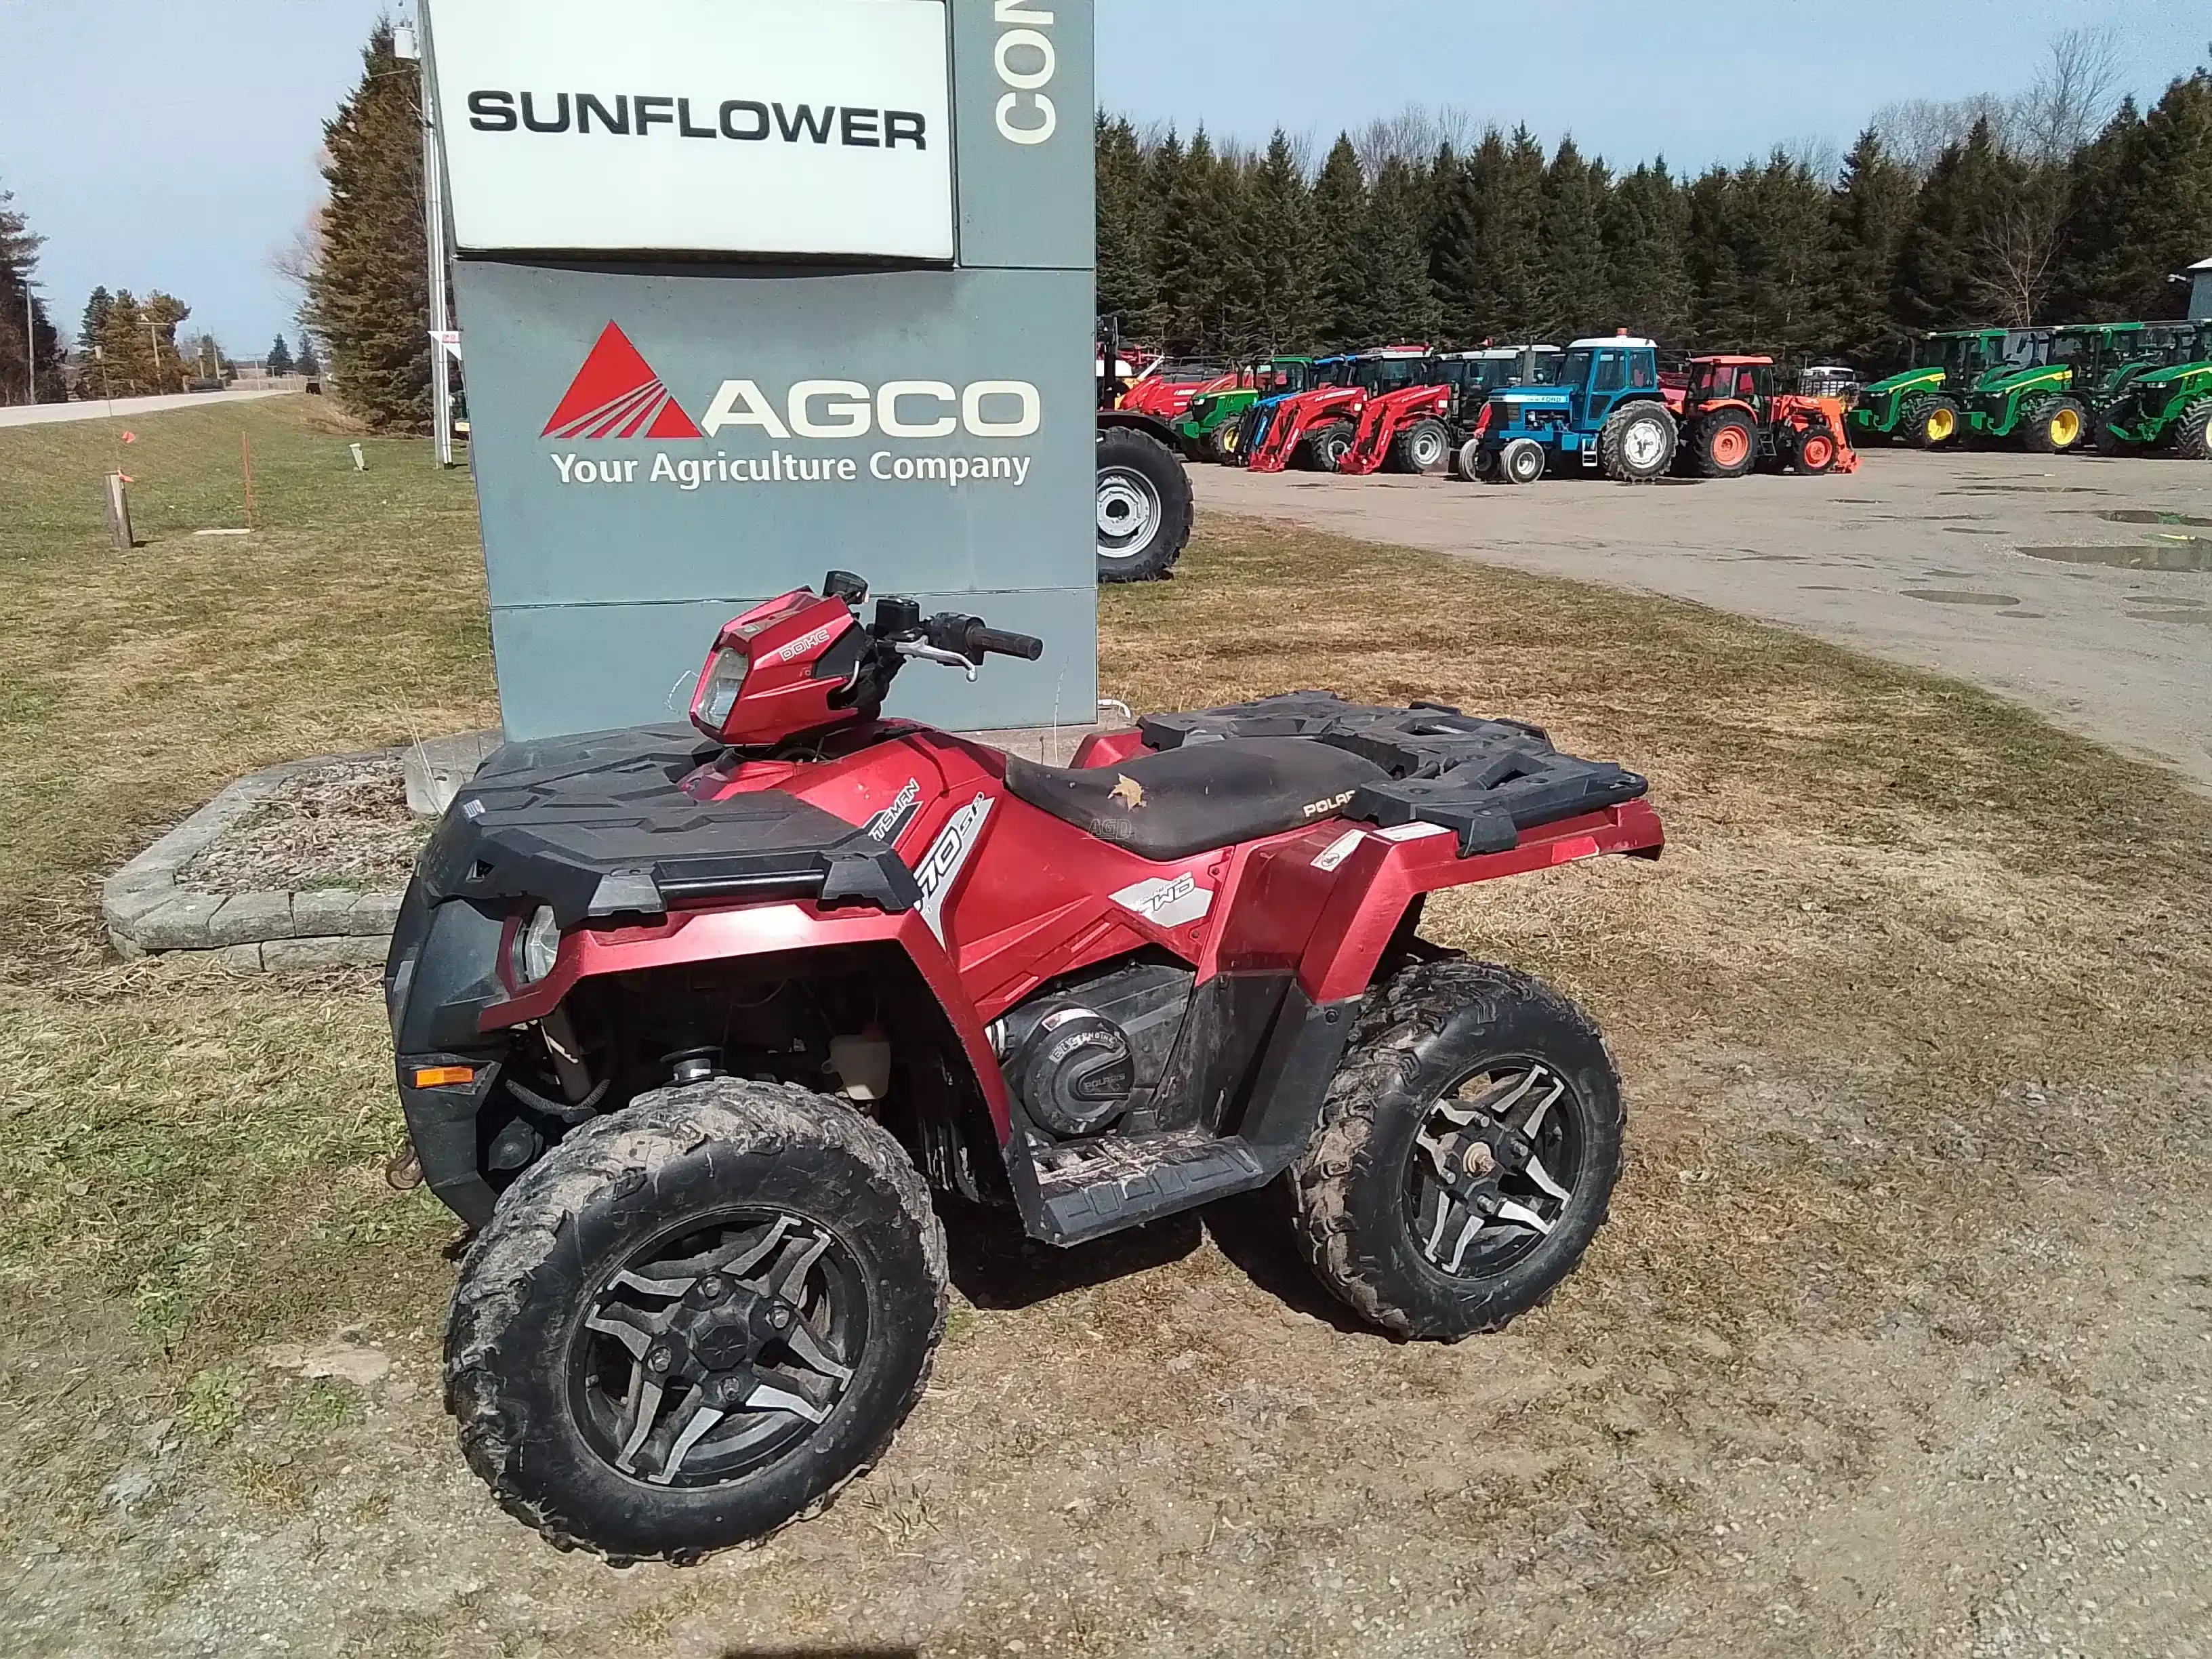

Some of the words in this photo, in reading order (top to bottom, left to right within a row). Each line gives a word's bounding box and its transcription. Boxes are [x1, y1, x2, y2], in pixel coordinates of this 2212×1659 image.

[468, 90, 926, 150] SUNFLOWER
[701, 380, 1041, 438] AGCO
[551, 453, 634, 483] Your
[649, 452, 857, 491] Agriculture
[869, 452, 1031, 487] Company
[914, 825, 962, 911] 70
